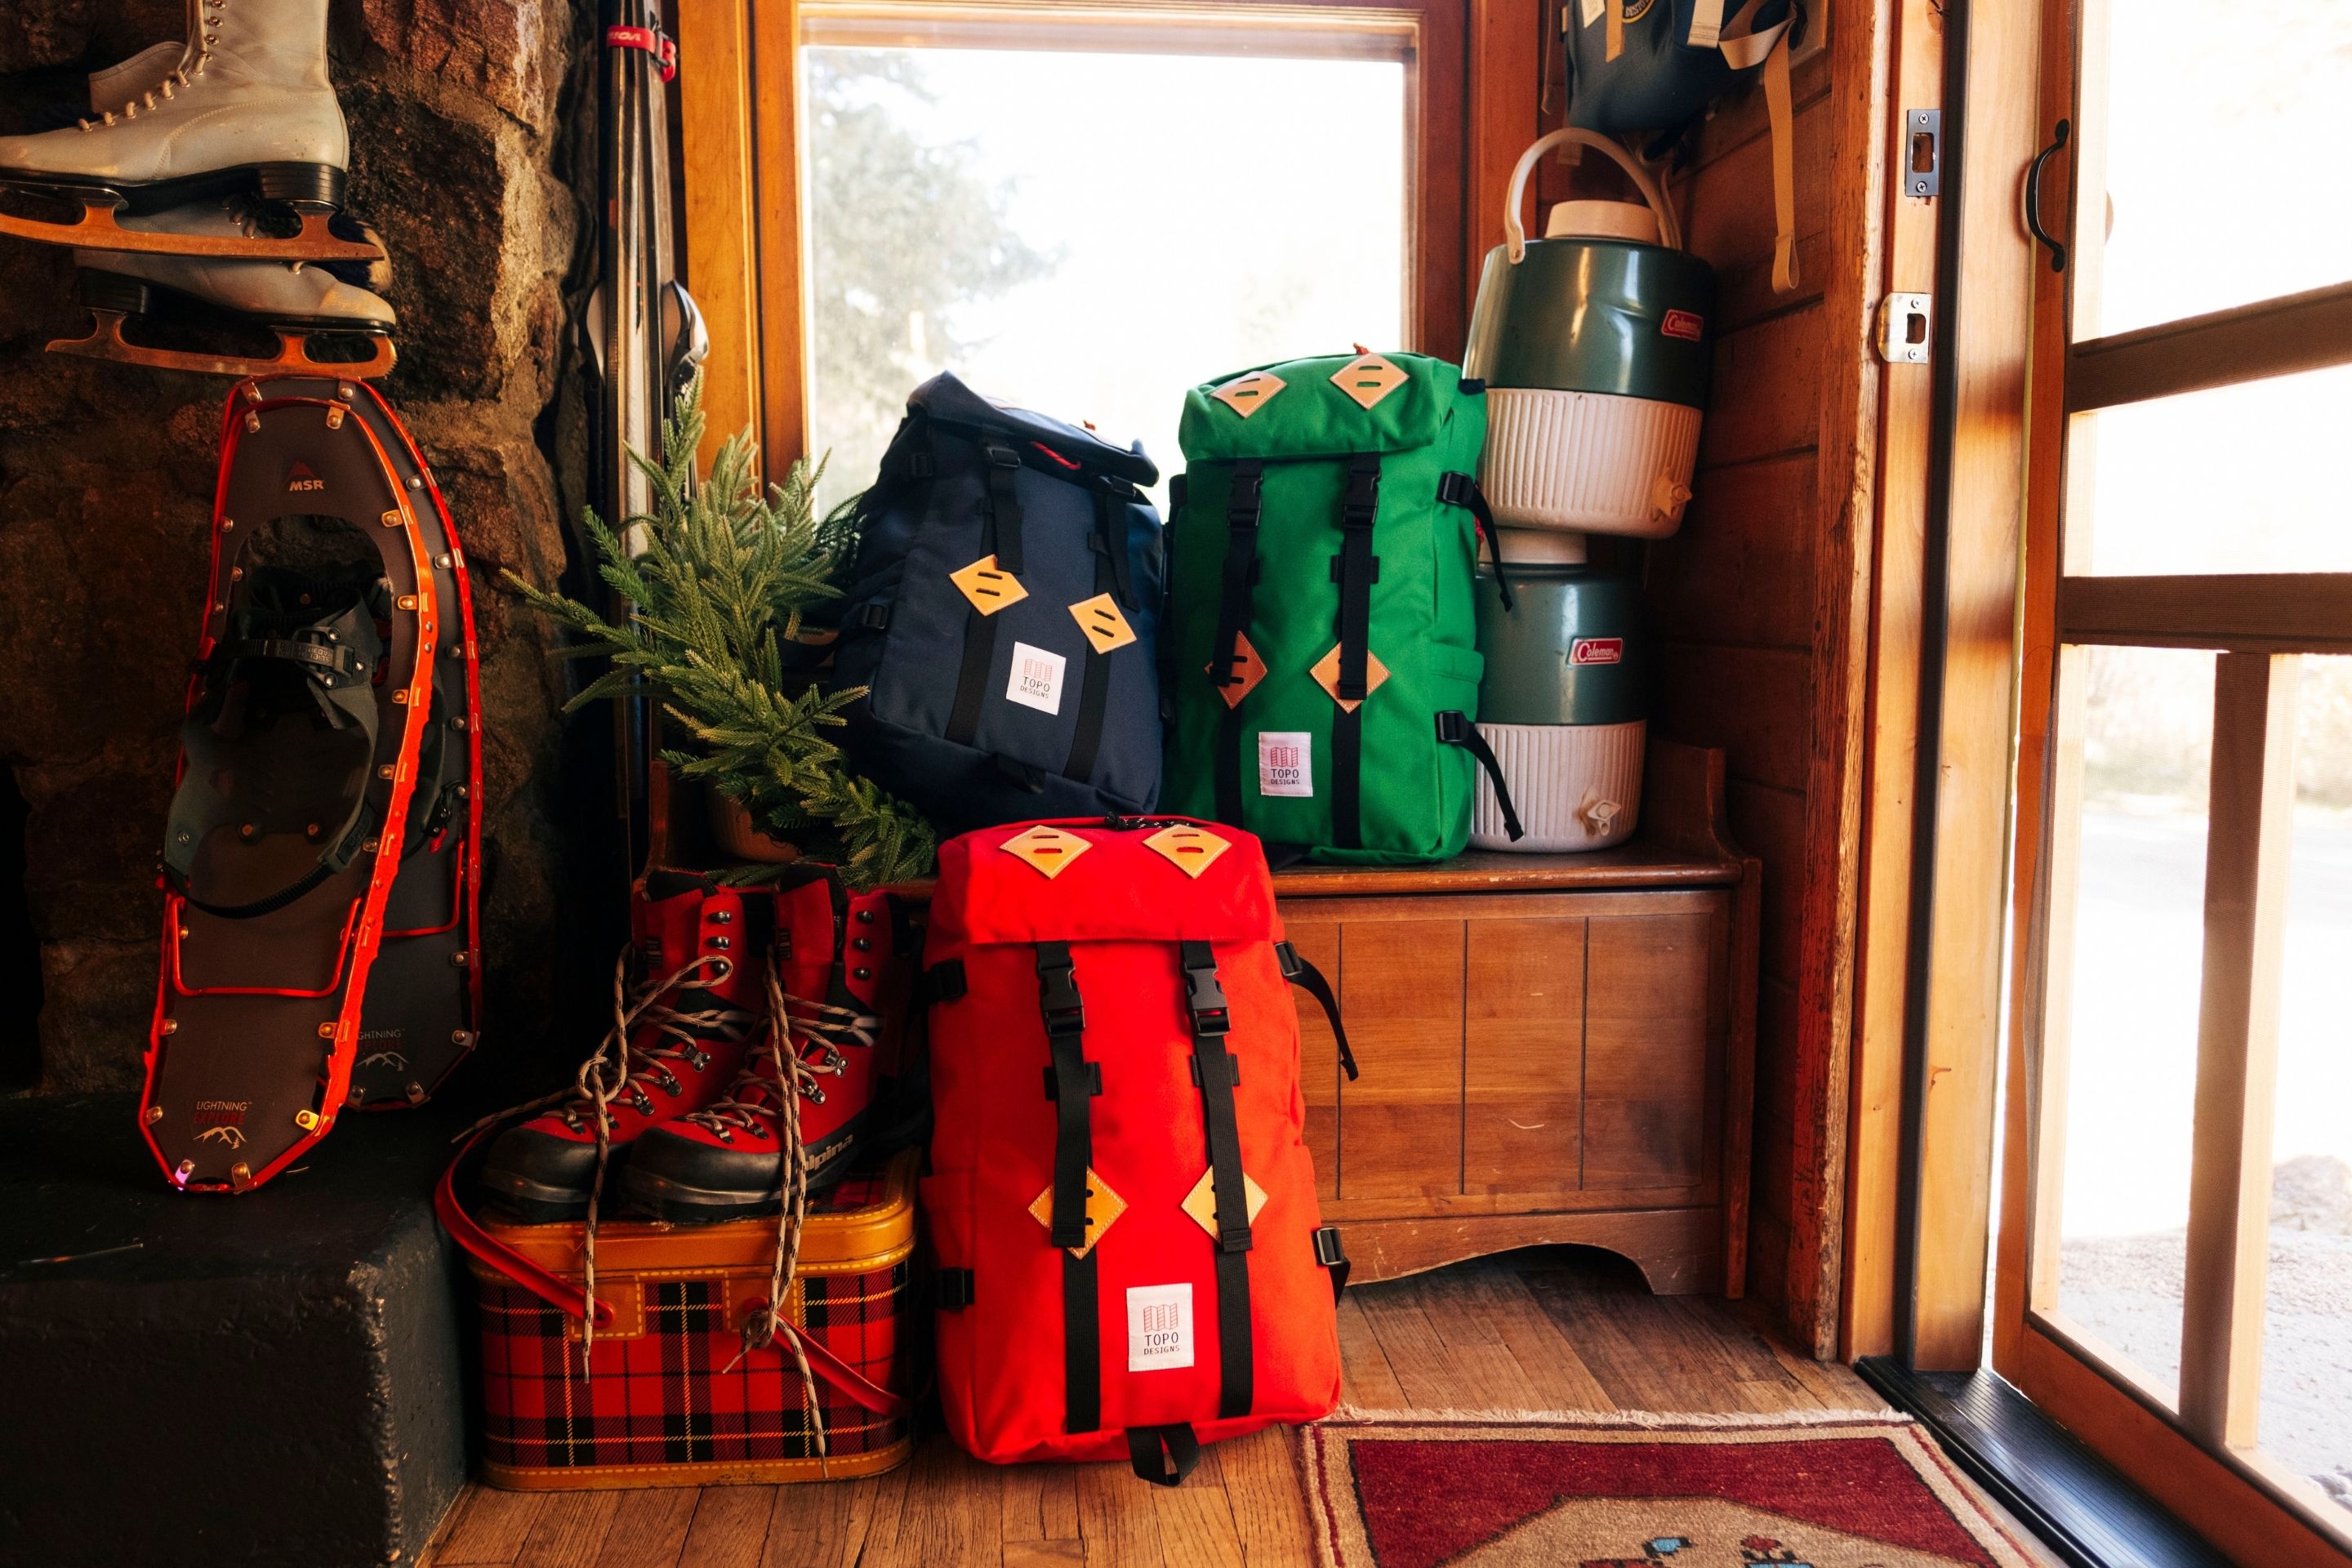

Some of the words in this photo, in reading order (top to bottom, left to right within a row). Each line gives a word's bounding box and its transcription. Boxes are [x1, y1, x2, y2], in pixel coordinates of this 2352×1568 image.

[289, 479, 324, 492] MSR
[1578, 643, 1614, 662] Coleman
[1023, 676, 1050, 693] TOPO
[1020, 686, 1049, 699] DESIGNS
[1271, 768, 1299, 778] TOPO
[358, 1029, 402, 1040] GHTNING
[197, 1100, 247, 1111] LIGHTNING
[194, 1111, 245, 1125] EXPLORE
[1144, 1332, 1178, 1347] TOPO
[1143, 1345, 1179, 1356] DESIGNS
